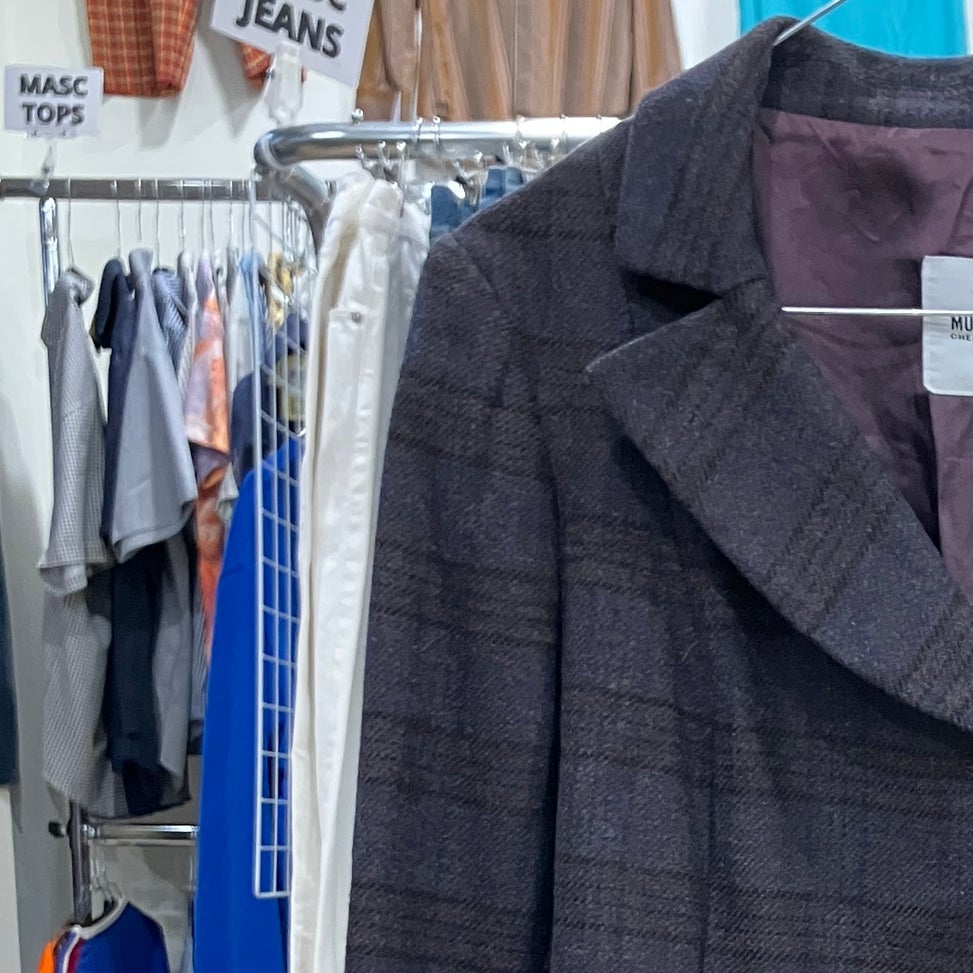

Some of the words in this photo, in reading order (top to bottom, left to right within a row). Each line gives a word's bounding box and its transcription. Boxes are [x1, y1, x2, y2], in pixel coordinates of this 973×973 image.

[235, 0, 344, 58] JEANS
[20, 73, 88, 96] MASC
[22, 102, 84, 126] TOPS
